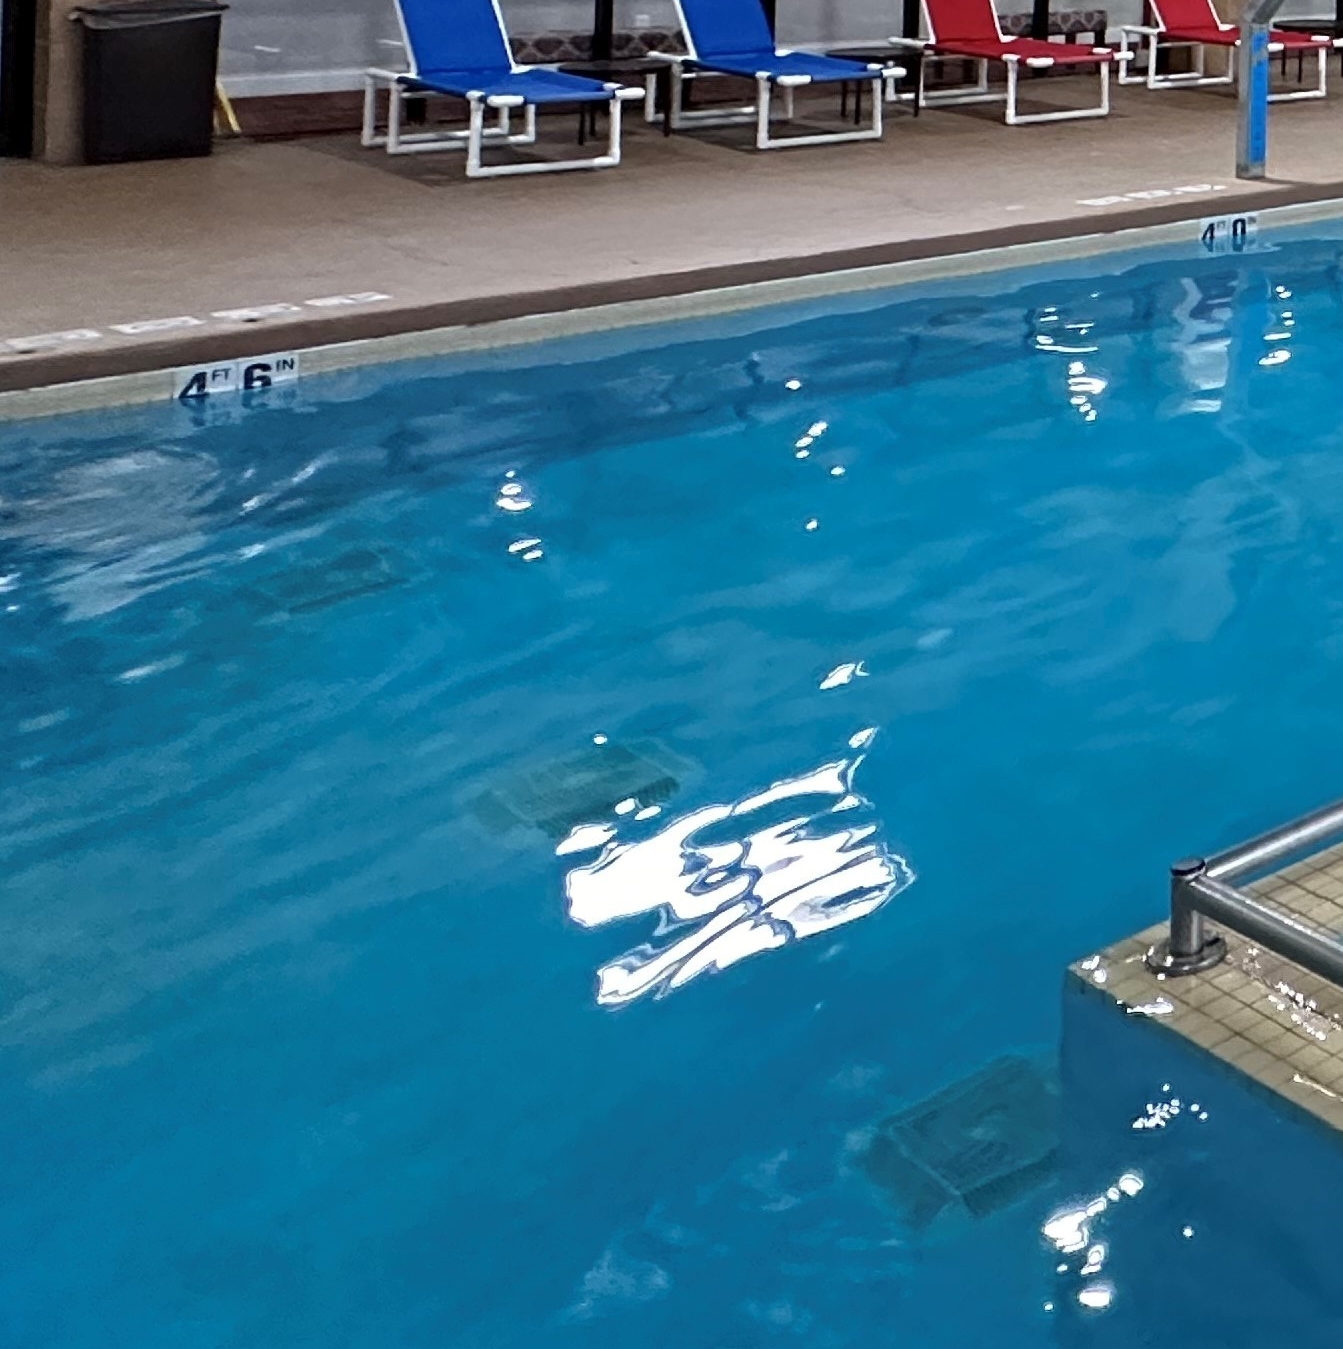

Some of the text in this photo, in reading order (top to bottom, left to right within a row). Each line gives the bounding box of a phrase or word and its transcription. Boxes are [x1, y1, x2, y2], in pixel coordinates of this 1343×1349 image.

[179, 357, 295, 399] 4 FT 6 IN
